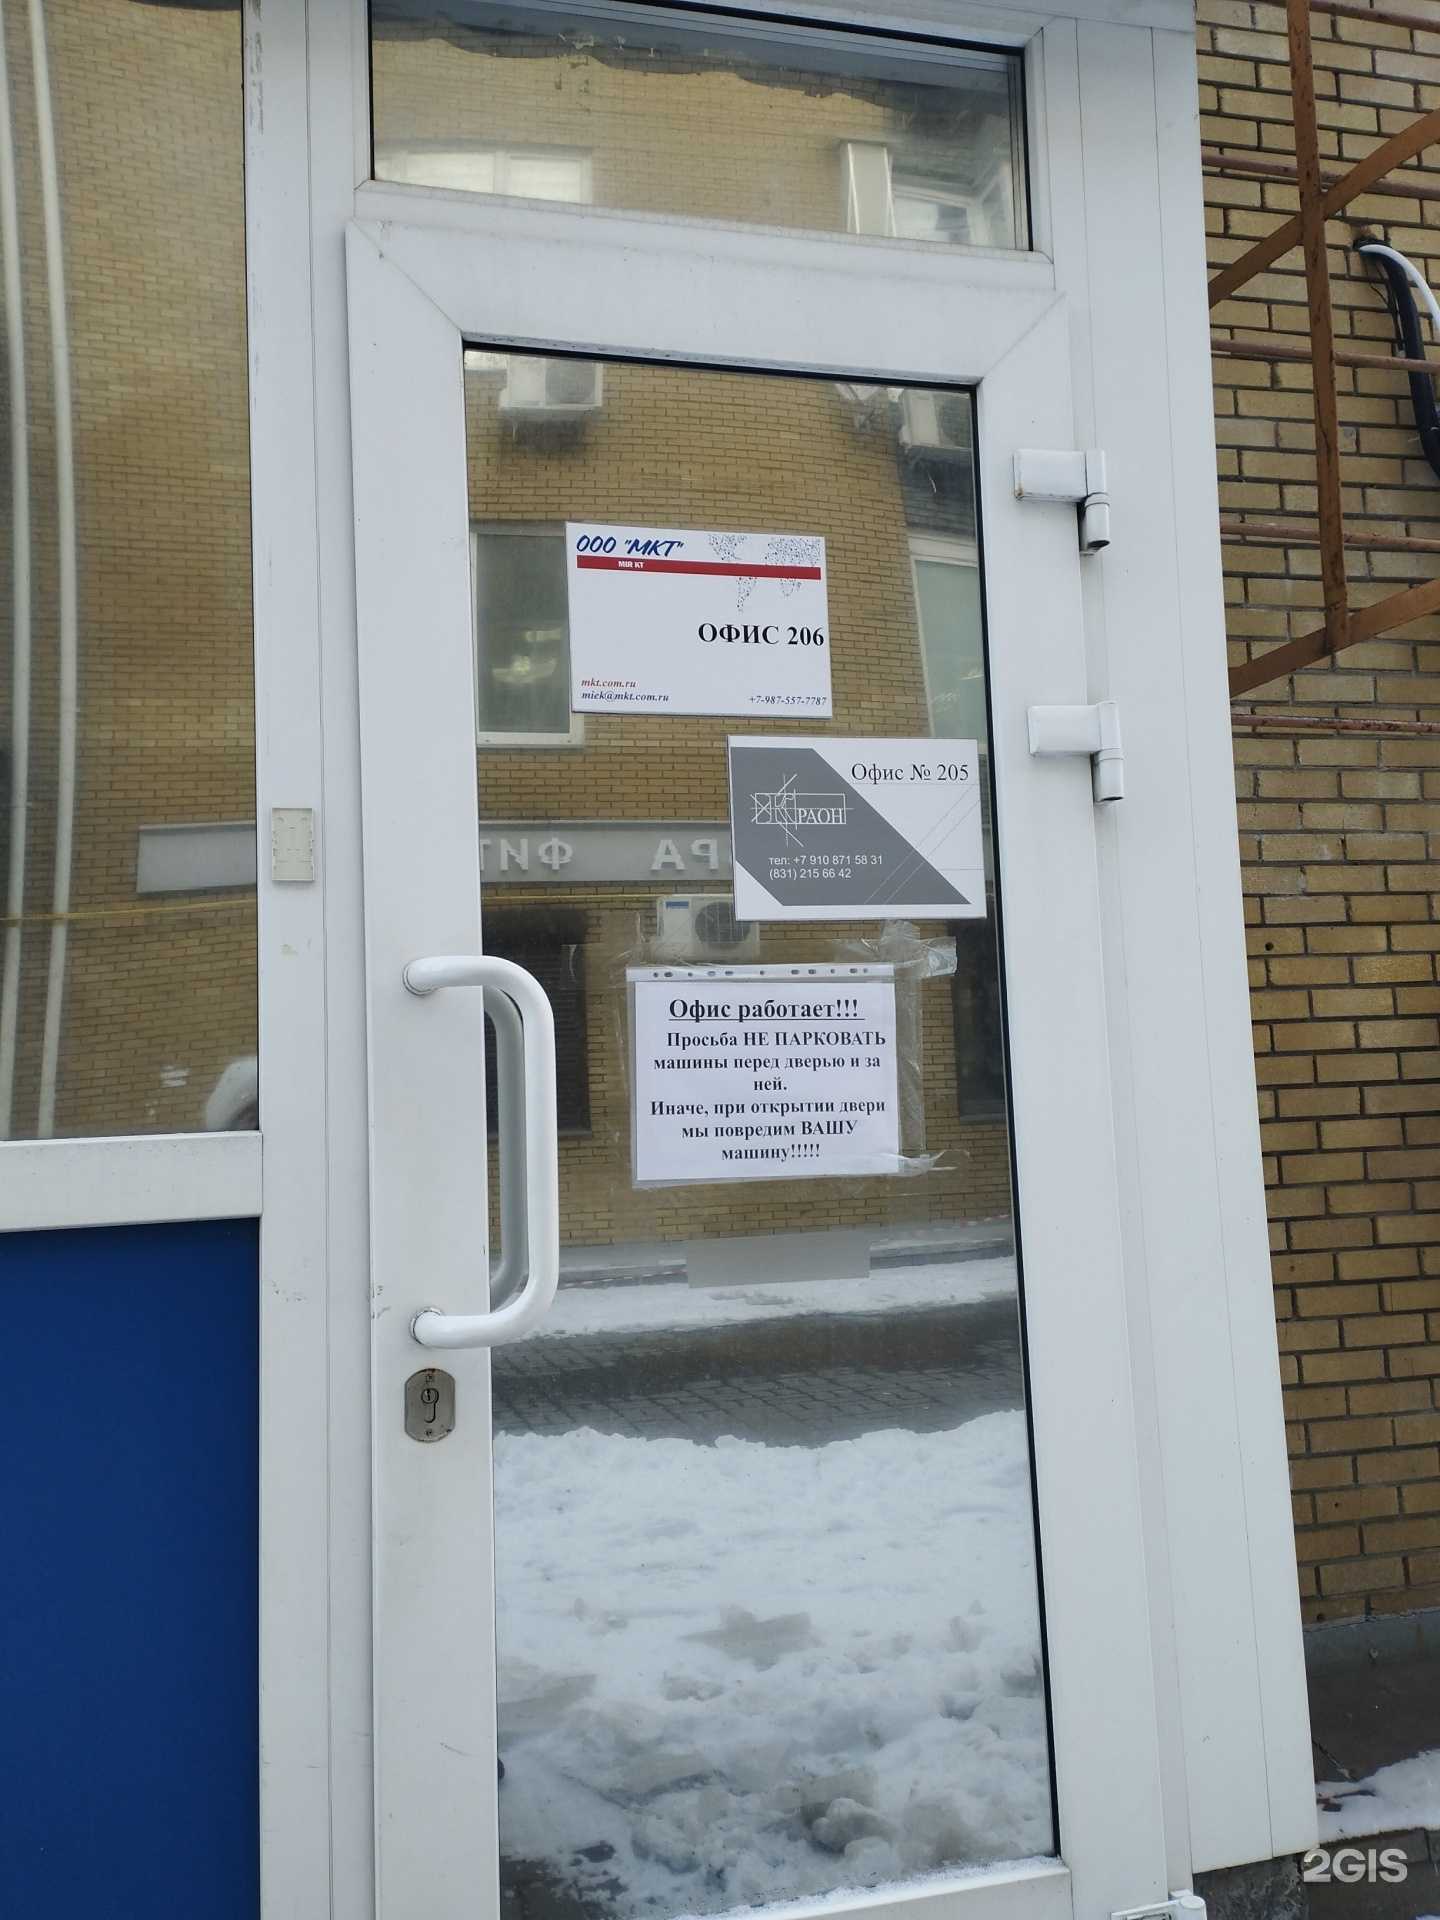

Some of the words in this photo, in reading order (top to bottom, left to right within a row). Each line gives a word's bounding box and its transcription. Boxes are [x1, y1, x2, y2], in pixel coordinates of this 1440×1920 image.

[577, 534, 617, 554] ООО
[624, 538, 685, 557] "МКТ"
[618, 560, 633, 569] MIR
[634, 561, 645, 570] KT
[698, 622, 779, 645] ОФИС
[787, 626, 824, 646] 206
[580, 677, 637, 688] mkt.com.ru
[749, 695, 827, 706] +7-987-557-7787
[851, 763, 904, 785] Офис
[936, 763, 969, 781] 205
[768, 857, 790, 865] тел:
[793, 855, 807, 865] +7
[809, 855, 830, 865] 910
[832, 855, 851, 865] 871
[855, 855, 868, 865] 58
[870, 855, 883, 865] 31
[769, 868, 797, 881] (831)
[800, 868, 820, 879] 215
[822, 868, 836, 879] 66
[838, 868, 852, 879] 42
[669, 999, 731, 1023] Офис
[738, 999, 858, 1023] работает!!!
[667, 1032, 738, 1051] Просьба
[743, 1031, 769, 1046] НЕ
[775, 1031, 886, 1046] ПАРКОВАТЬ
[654, 1059, 728, 1070] машины
[734, 1057, 780, 1073] перед
[784, 1056, 845, 1072] дверью
[850, 1057, 860, 1068] и
[864, 1056, 881, 1068] за
[753, 1076, 787, 1091] ней.
[650, 1100, 709, 1116] Иначе,
[714, 1103, 745, 1118] при
[751, 1101, 834, 1117] открытии
[839, 1101, 886, 1116] двери
[681, 1127, 708, 1138] мы
[714, 1125, 796, 1141] повредим
[801, 1119, 858, 1135] ВАШУ
[721, 1143, 820, 1162] машину!!!!!
